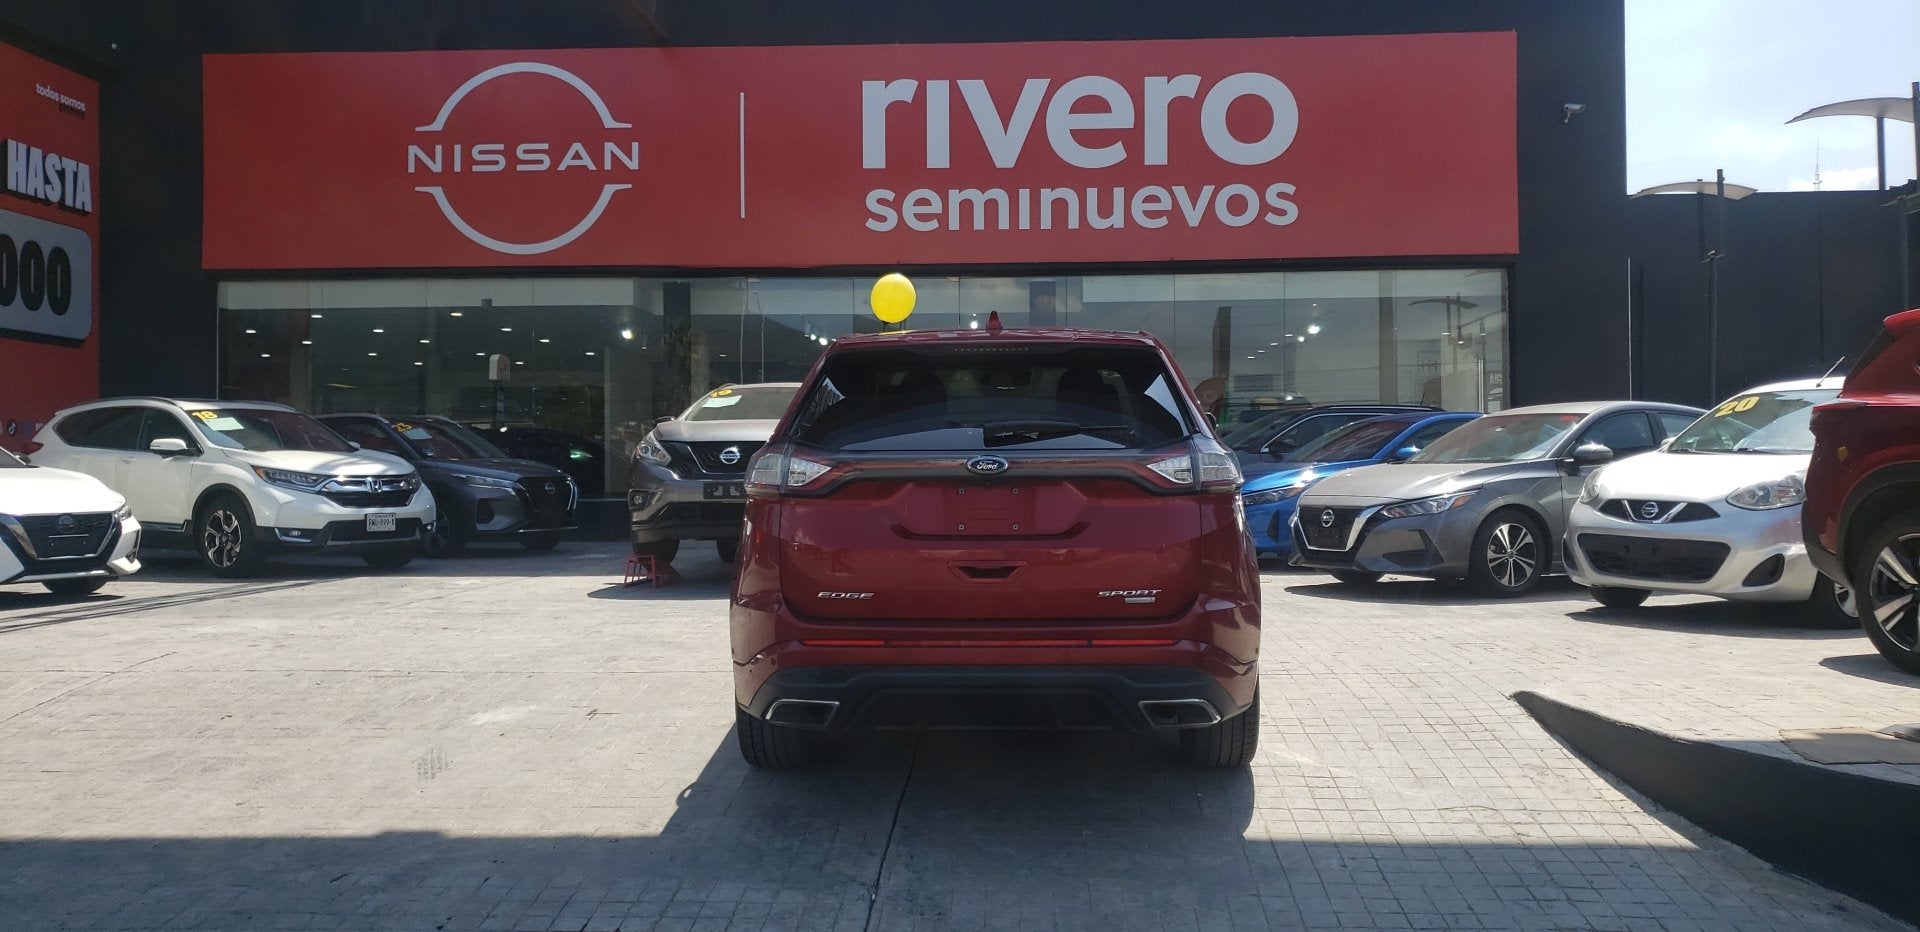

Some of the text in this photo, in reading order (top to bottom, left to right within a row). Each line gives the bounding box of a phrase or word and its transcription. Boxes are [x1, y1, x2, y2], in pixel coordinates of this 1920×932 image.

[36, 82, 60, 102] todos
[60, 94, 86, 111] somos
[862, 72, 1299, 169] rivero
[407, 141, 639, 173] NISSAN
[7, 138, 93, 213] HASTA
[865, 182, 1299, 232] seminuevos
[191, 411, 218, 420] 18
[1713, 396, 1760, 418] 20
[976, 460, 999, 470] Ford
[817, 591, 875, 600] EDGE
[1097, 589, 1163, 597] SPORT
